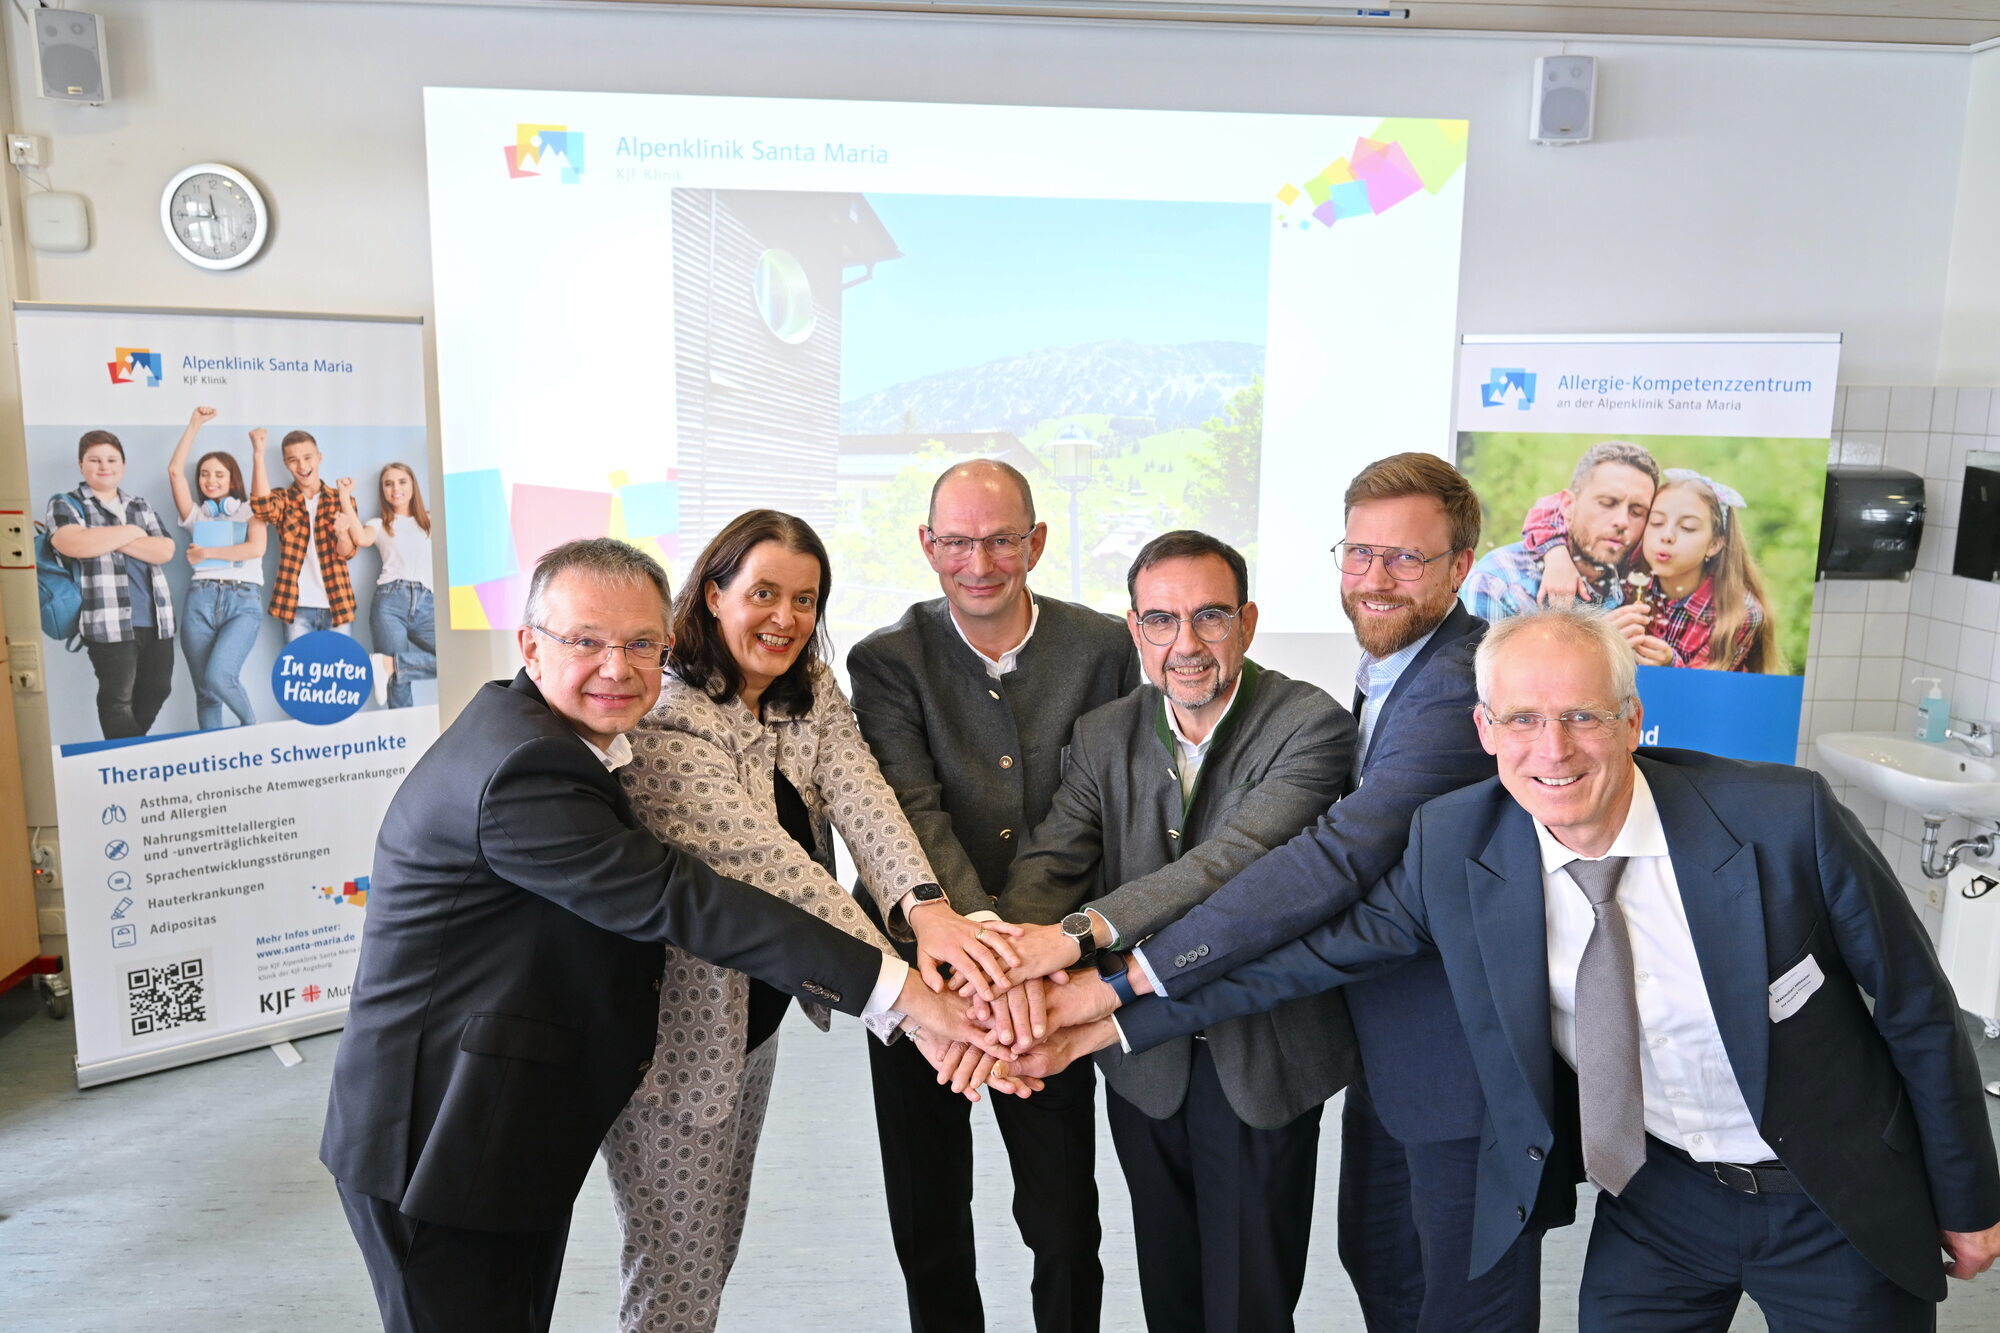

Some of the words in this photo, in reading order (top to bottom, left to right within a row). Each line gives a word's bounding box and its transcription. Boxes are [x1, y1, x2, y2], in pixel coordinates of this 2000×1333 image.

[616, 136, 744, 161] Alpenklinik
[752, 140, 815, 162] Santa
[824, 143, 888, 164] Maria
[616, 167, 638, 182] KJF
[644, 168, 683, 181] Klinik
[182, 355, 265, 372] Alpenklinik
[269, 358, 309, 372] Santa
[314, 359, 353, 373] Maria
[183, 375, 198, 386] KJF
[201, 375, 227, 385] Klinik
[1557, 375, 1812, 395] Allergie-Kompetenzzentrum
[1557, 401, 1571, 409] an
[1575, 398, 1593, 409] der
[1598, 398, 1664, 411] Alpenklinik
[1668, 399, 1702, 410] Santa
[1706, 400, 1742, 411] Maria
[280, 655, 304, 676] In
[309, 658, 367, 684] guten
[284, 680, 360, 705] Händen
[98, 751, 263, 785] Therapeutische
[271, 735, 407, 764] Schwerpunkte
[140, 794, 192, 809] Asthma,
[196, 784, 262, 801] chronische
[266, 766, 406, 792] Atemwegserkrankungen
[141, 811, 165, 824] und
[170, 804, 227, 821] Allergien
[143, 816, 296, 846] Nahrungsmittelallergien
[144, 848, 168, 862] und
[172, 830, 298, 857] -unverträglichkeiten
[146, 846, 331, 885] Sprachentwicklungsstörungen
[148, 882, 265, 910] Hauterkrankungen
[150, 915, 217, 935] Adipositas
[256, 934, 281, 946] Mehr
[285, 929, 309, 940] Infos
[312, 924, 341, 936] unter:
[256, 933, 355, 959] www.santa-maria.de
[260, 988, 295, 1015] KJF
[327, 985, 351, 999] Mut
